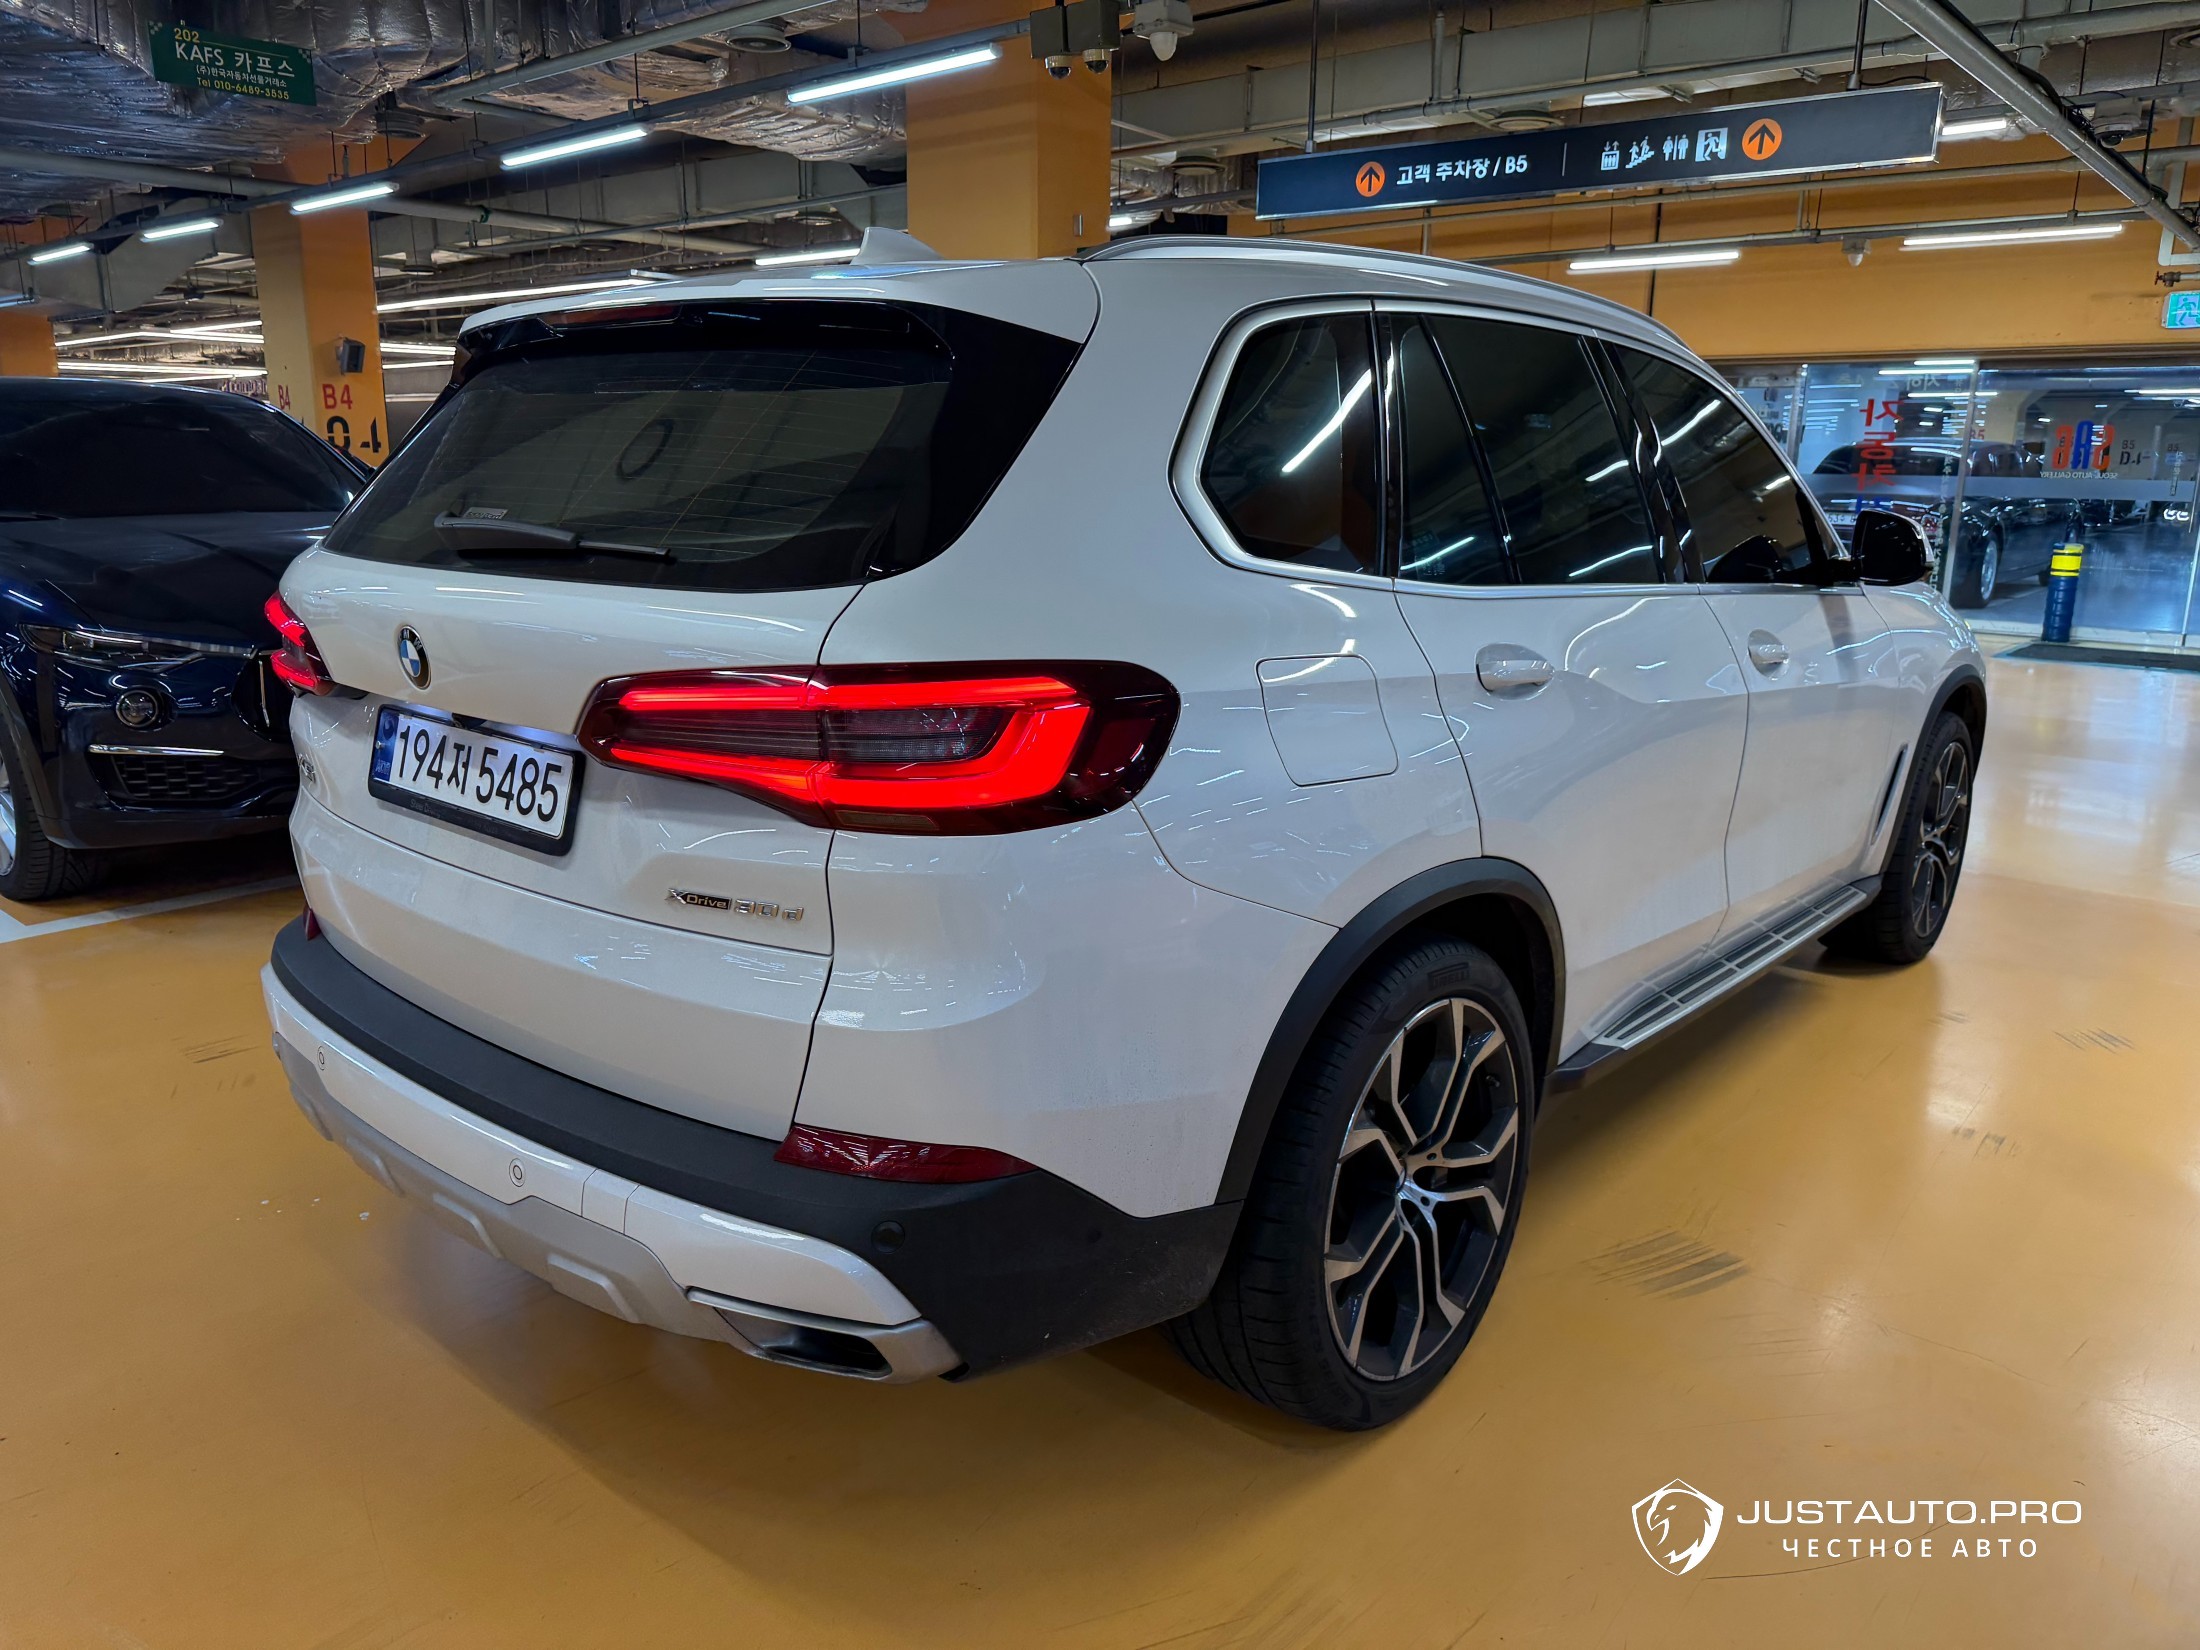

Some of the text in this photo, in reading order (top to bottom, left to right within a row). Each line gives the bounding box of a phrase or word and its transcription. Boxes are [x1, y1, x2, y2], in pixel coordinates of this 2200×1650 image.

[174, 28, 200, 43] 202
[175, 41, 295, 77] KAFS 카프스
[197, 77, 211, 87] Tel
[1397, 164, 1431, 186] 고객
[1436, 158, 1489, 182] 주차장
[1505, 155, 1528, 175] B5
[278, 385, 291, 410] B4
[322, 384, 353, 410] B4
[399, 725, 562, 822] 194저 5485
